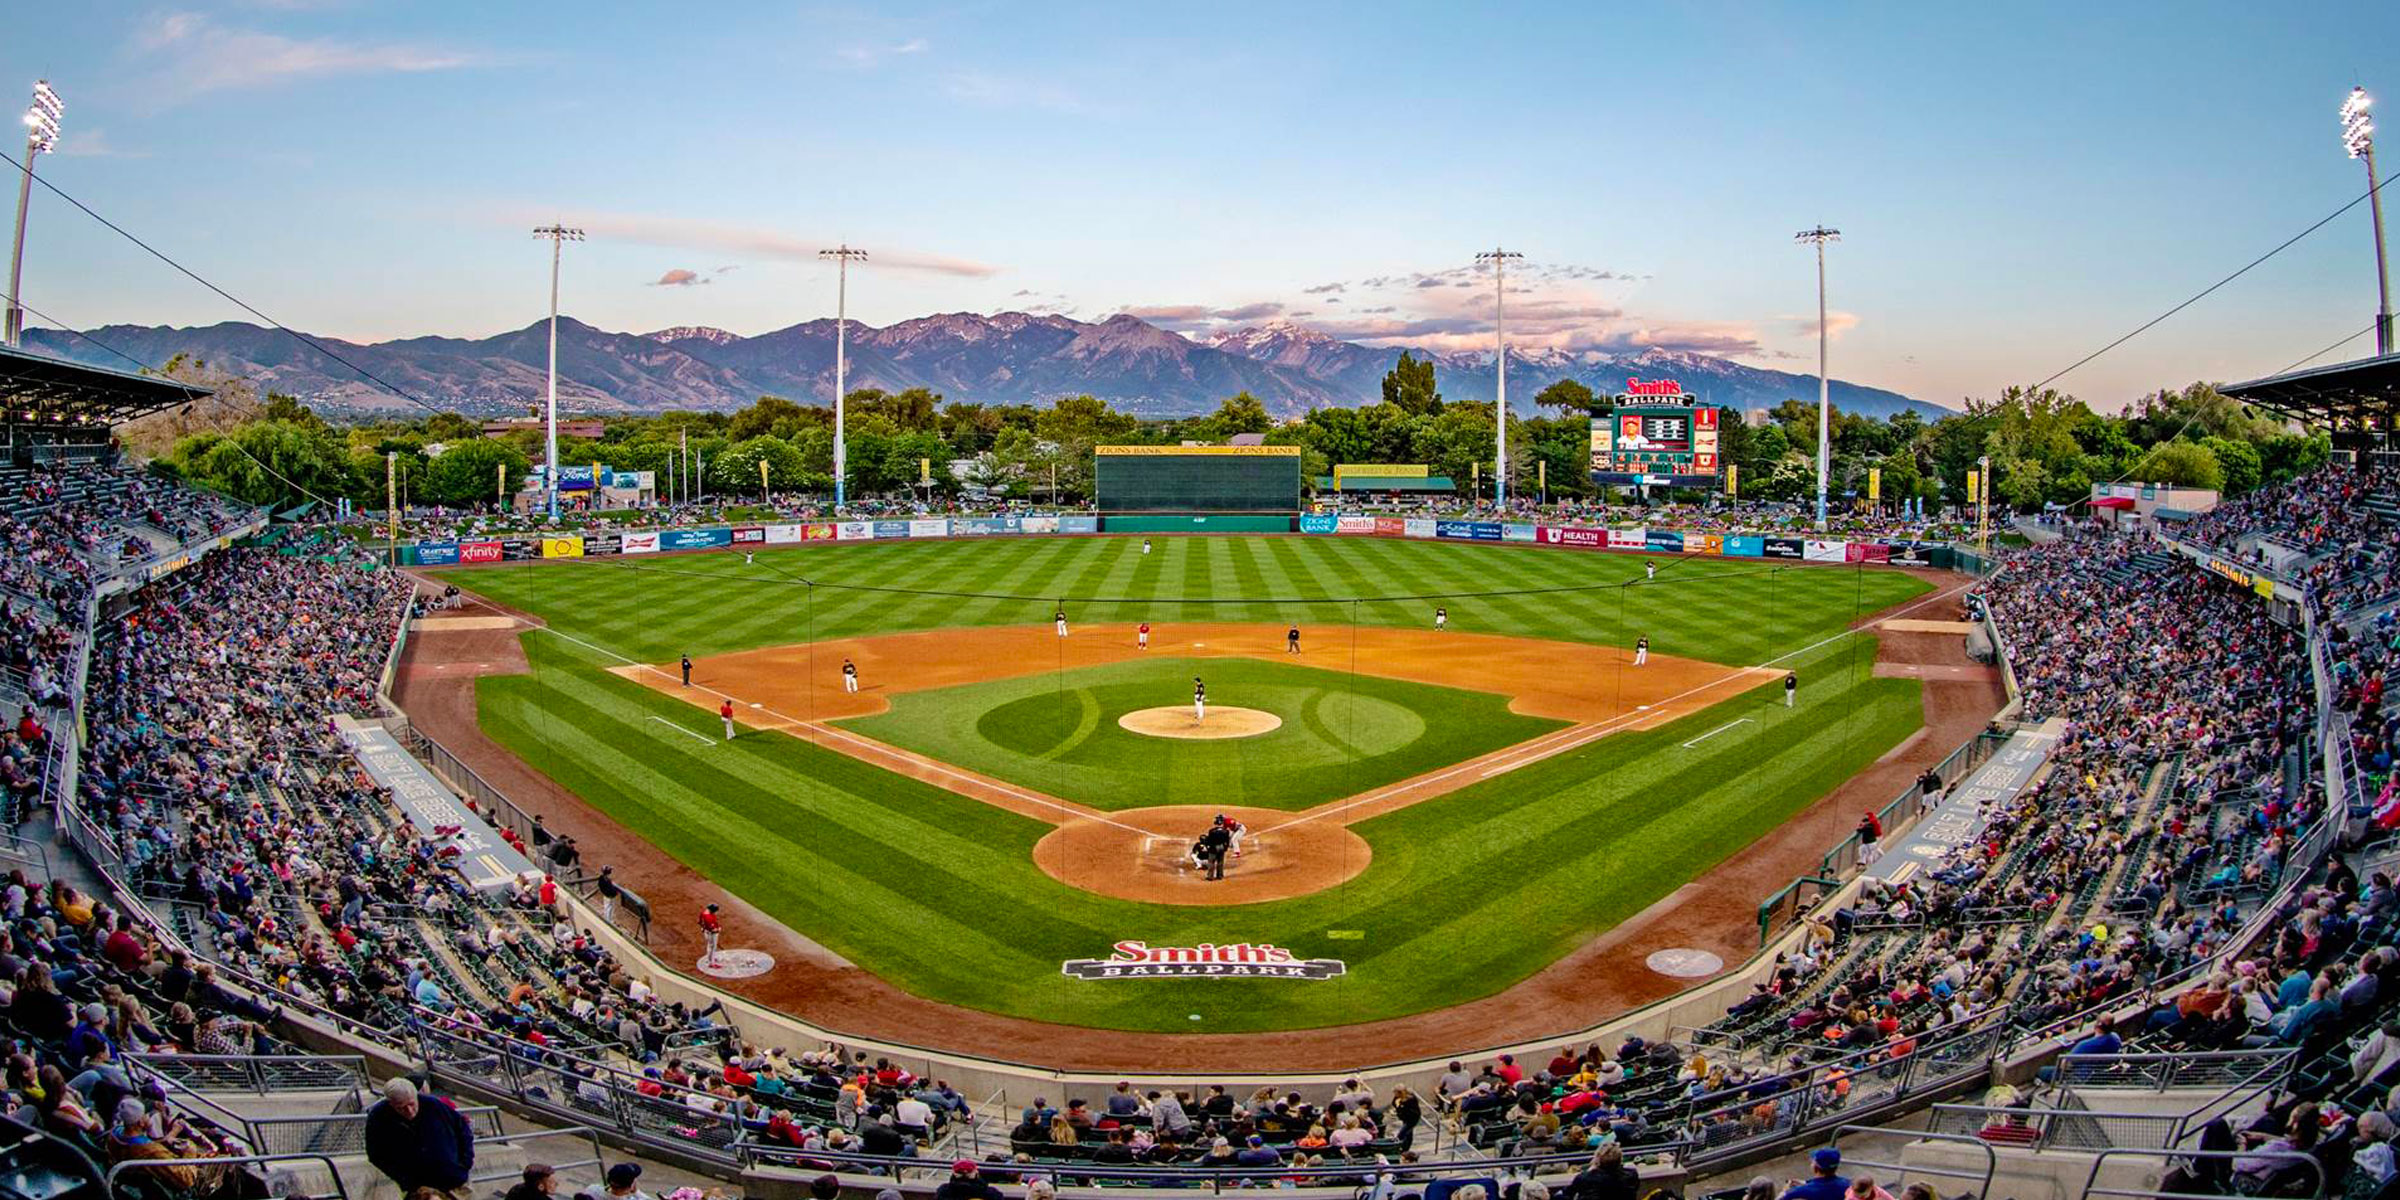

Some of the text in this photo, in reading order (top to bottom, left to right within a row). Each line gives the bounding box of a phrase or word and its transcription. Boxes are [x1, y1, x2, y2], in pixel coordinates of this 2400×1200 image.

[1626, 377, 1682, 396] Smith's
[1625, 396, 1684, 405] BALLPARK
[562, 467, 592, 480] Ford
[1339, 517, 1374, 529] Smith's
[1563, 531, 1598, 541] HEALTH
[461, 545, 500, 561] xfinity
[1112, 940, 1290, 962] Smith's
[1102, 964, 1306, 977] BALLPARK
